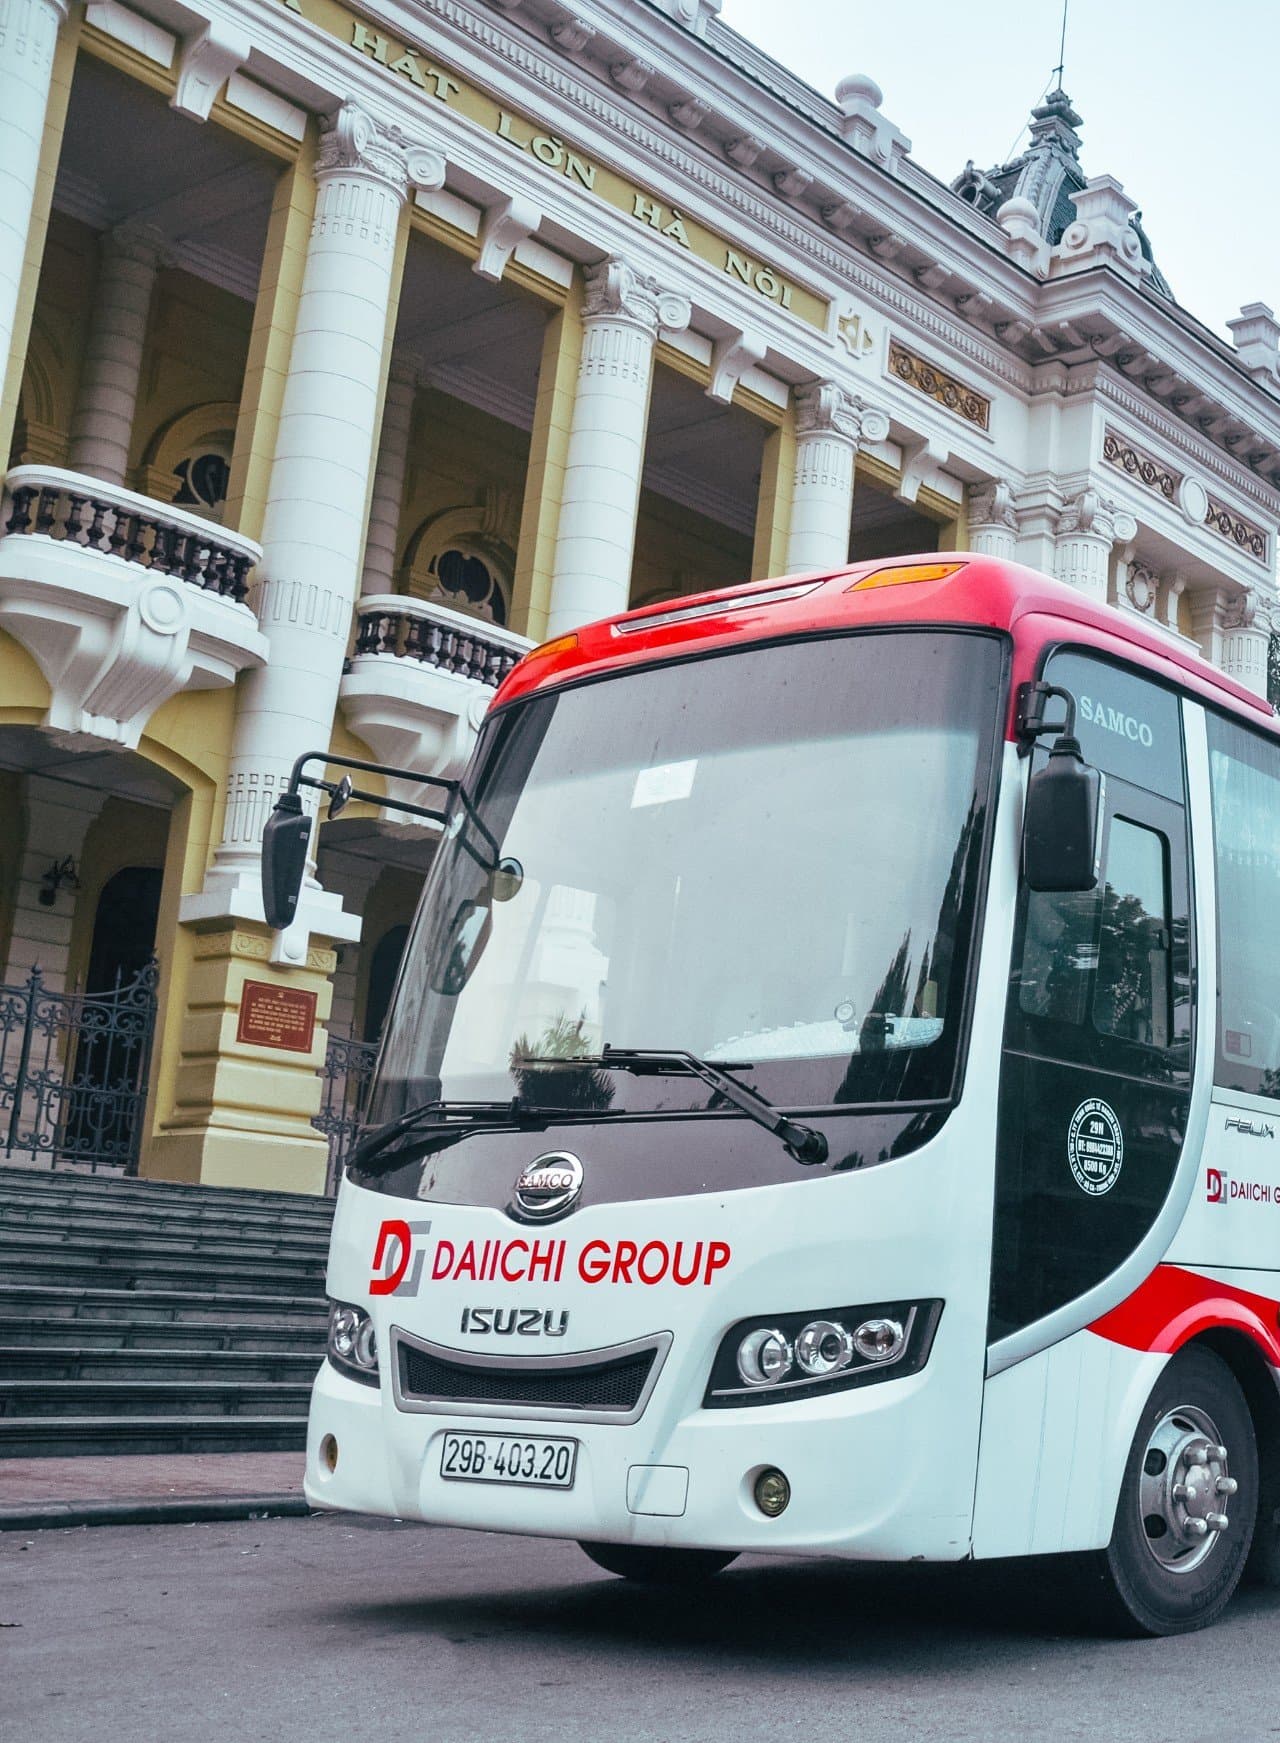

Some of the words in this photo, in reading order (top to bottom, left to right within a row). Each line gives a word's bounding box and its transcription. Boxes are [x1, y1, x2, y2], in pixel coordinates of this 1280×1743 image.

[352, 22, 460, 101] HÁT
[633, 193, 691, 249] HÀ
[1080, 695, 1153, 748] SAMCO
[1225, 1117, 1275, 1140] FELIX
[517, 1173, 574, 1190] SAMCO
[1230, 1180, 1271, 1203] DAIICHI
[431, 1239, 567, 1282] DAIICHI
[578, 1239, 731, 1286] GROUP
[460, 1307, 571, 1336] ISUZU
